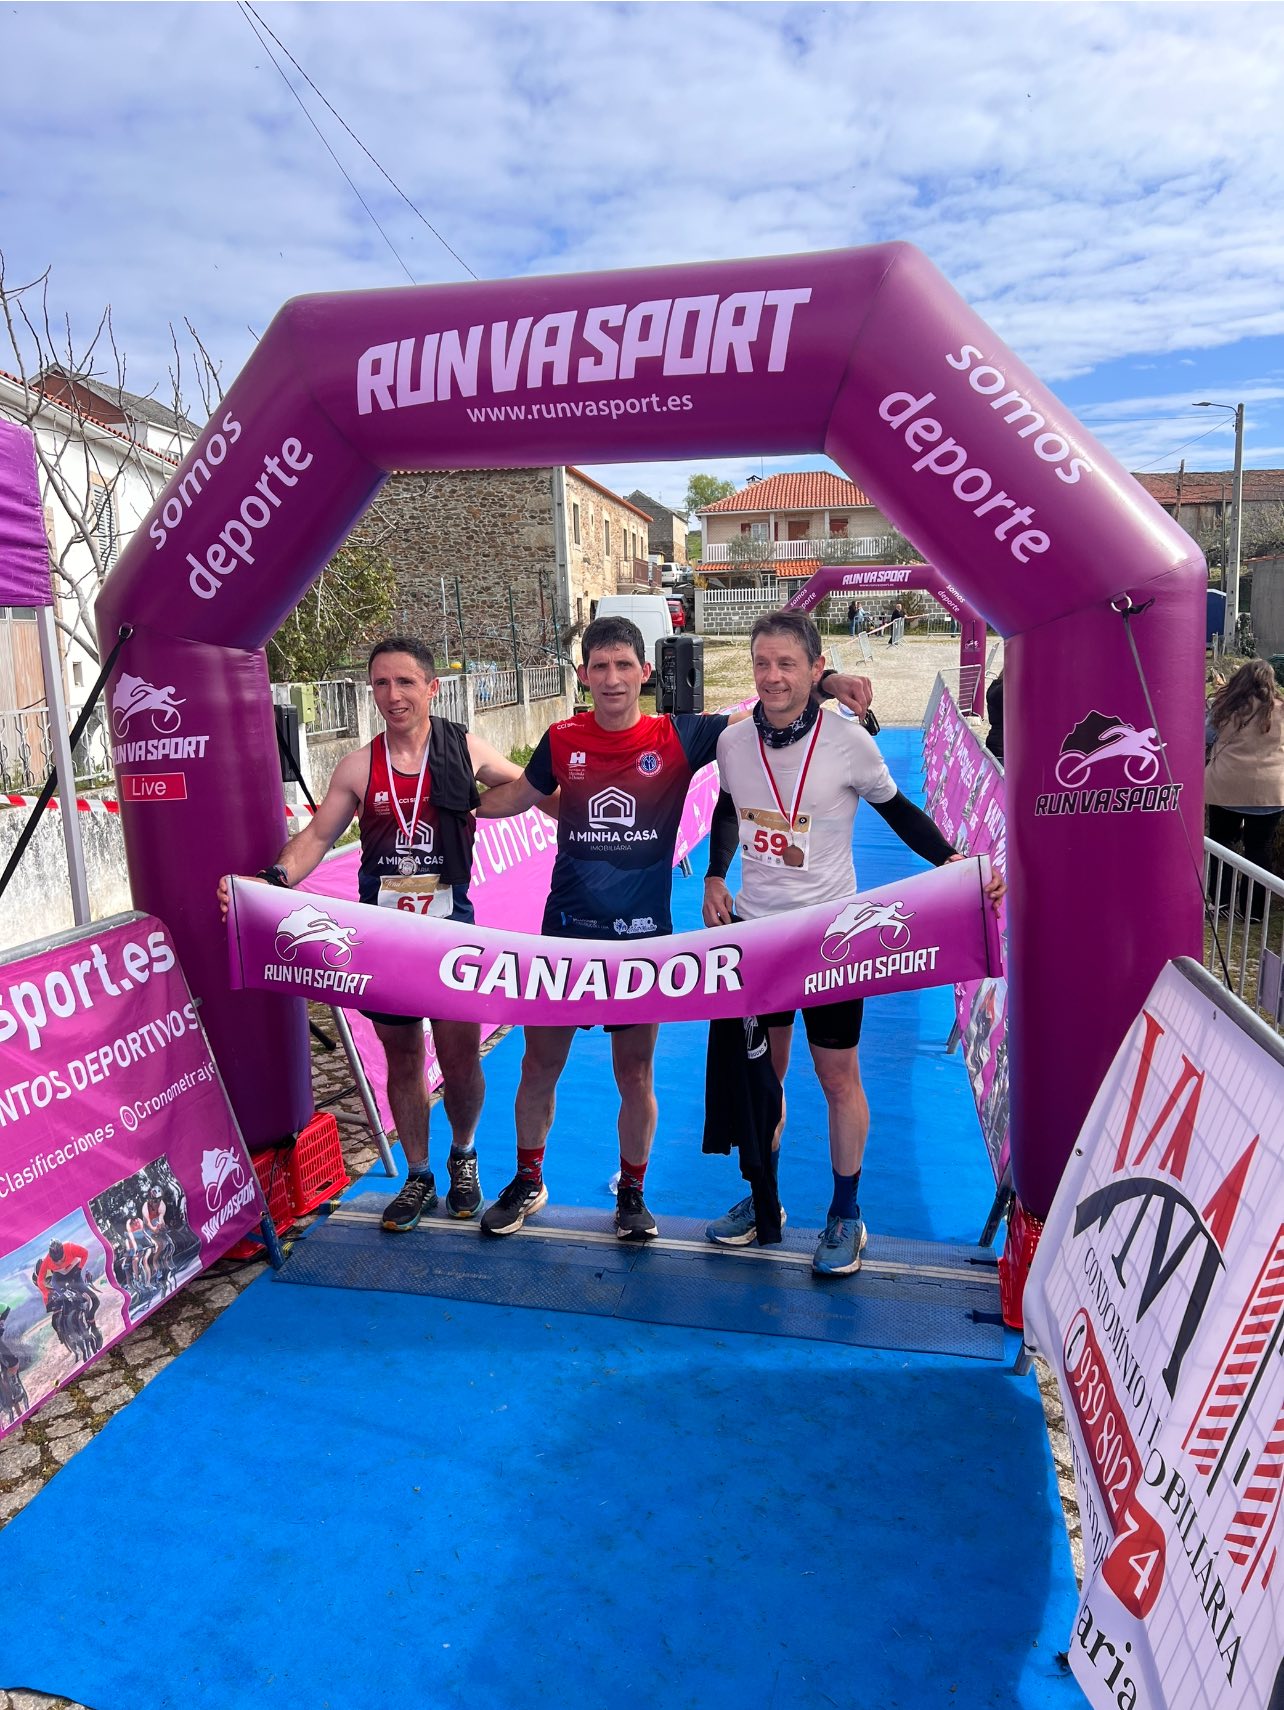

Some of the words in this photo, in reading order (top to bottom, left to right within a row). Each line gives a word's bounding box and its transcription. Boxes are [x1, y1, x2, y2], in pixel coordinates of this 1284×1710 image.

[466, 392, 694, 424] www.runvasport.es
[945, 344, 1093, 484] somos
[150, 411, 242, 550] somos
[878, 391, 1051, 564] deporte
[185, 437, 313, 600] deporte
[790, 588, 808, 608] somos
[801, 592, 817, 609] porte
[937, 590, 960, 612] deporte
[946, 584, 965, 603] somos
[132, 778, 167, 796] Live
[569, 830, 576, 841] A
[577, 831, 621, 842] MINHA
[624, 829, 658, 841] CASA
[754, 829, 788, 857] 59
[377, 856, 385, 865] A
[397, 895, 434, 915] 67
[438, 944, 744, 1002] GANADOR
[68, 1003, 199, 1092] DEPORTIVOS
[1084, 1247, 1146, 1408] CONDOMÍNIO
[1074, 1346, 1105, 1425] 939
[1096, 1411, 1132, 1513] 802
